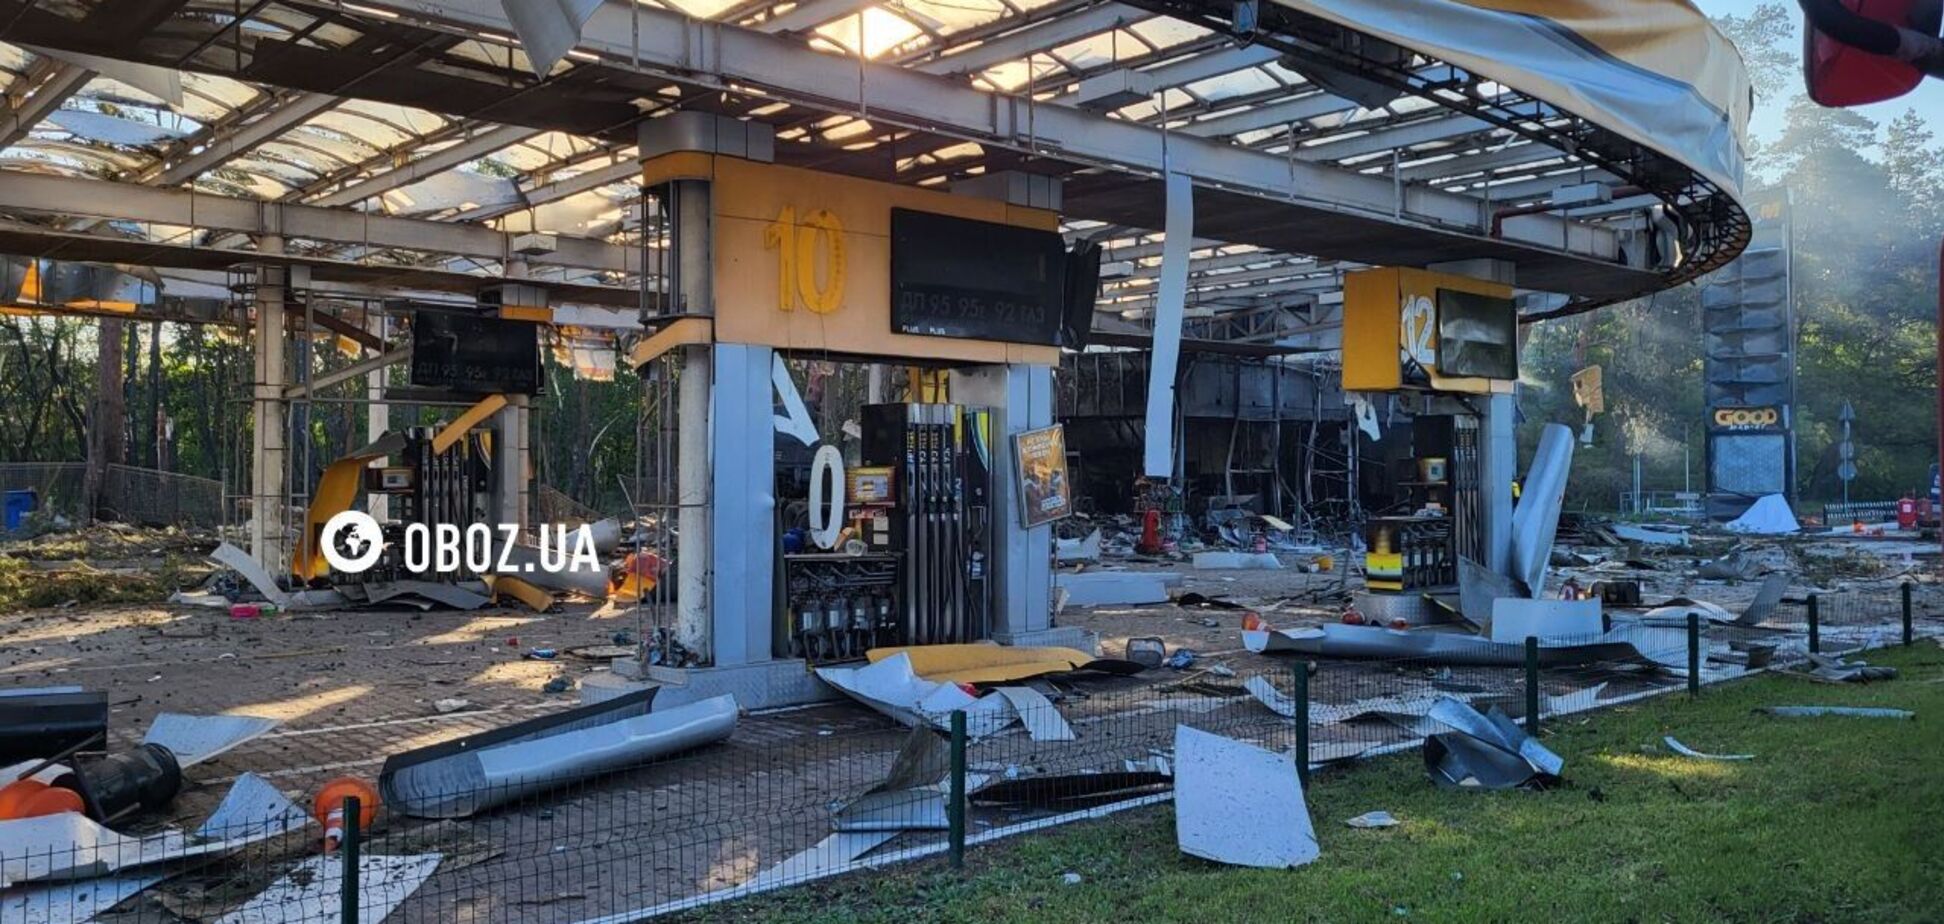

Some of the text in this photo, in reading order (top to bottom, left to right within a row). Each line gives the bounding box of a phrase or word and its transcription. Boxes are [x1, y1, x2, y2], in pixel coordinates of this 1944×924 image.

[764, 204, 847, 314] 10
[1402, 294, 1435, 364] 12
[1715, 408, 1777, 427] GOOD
